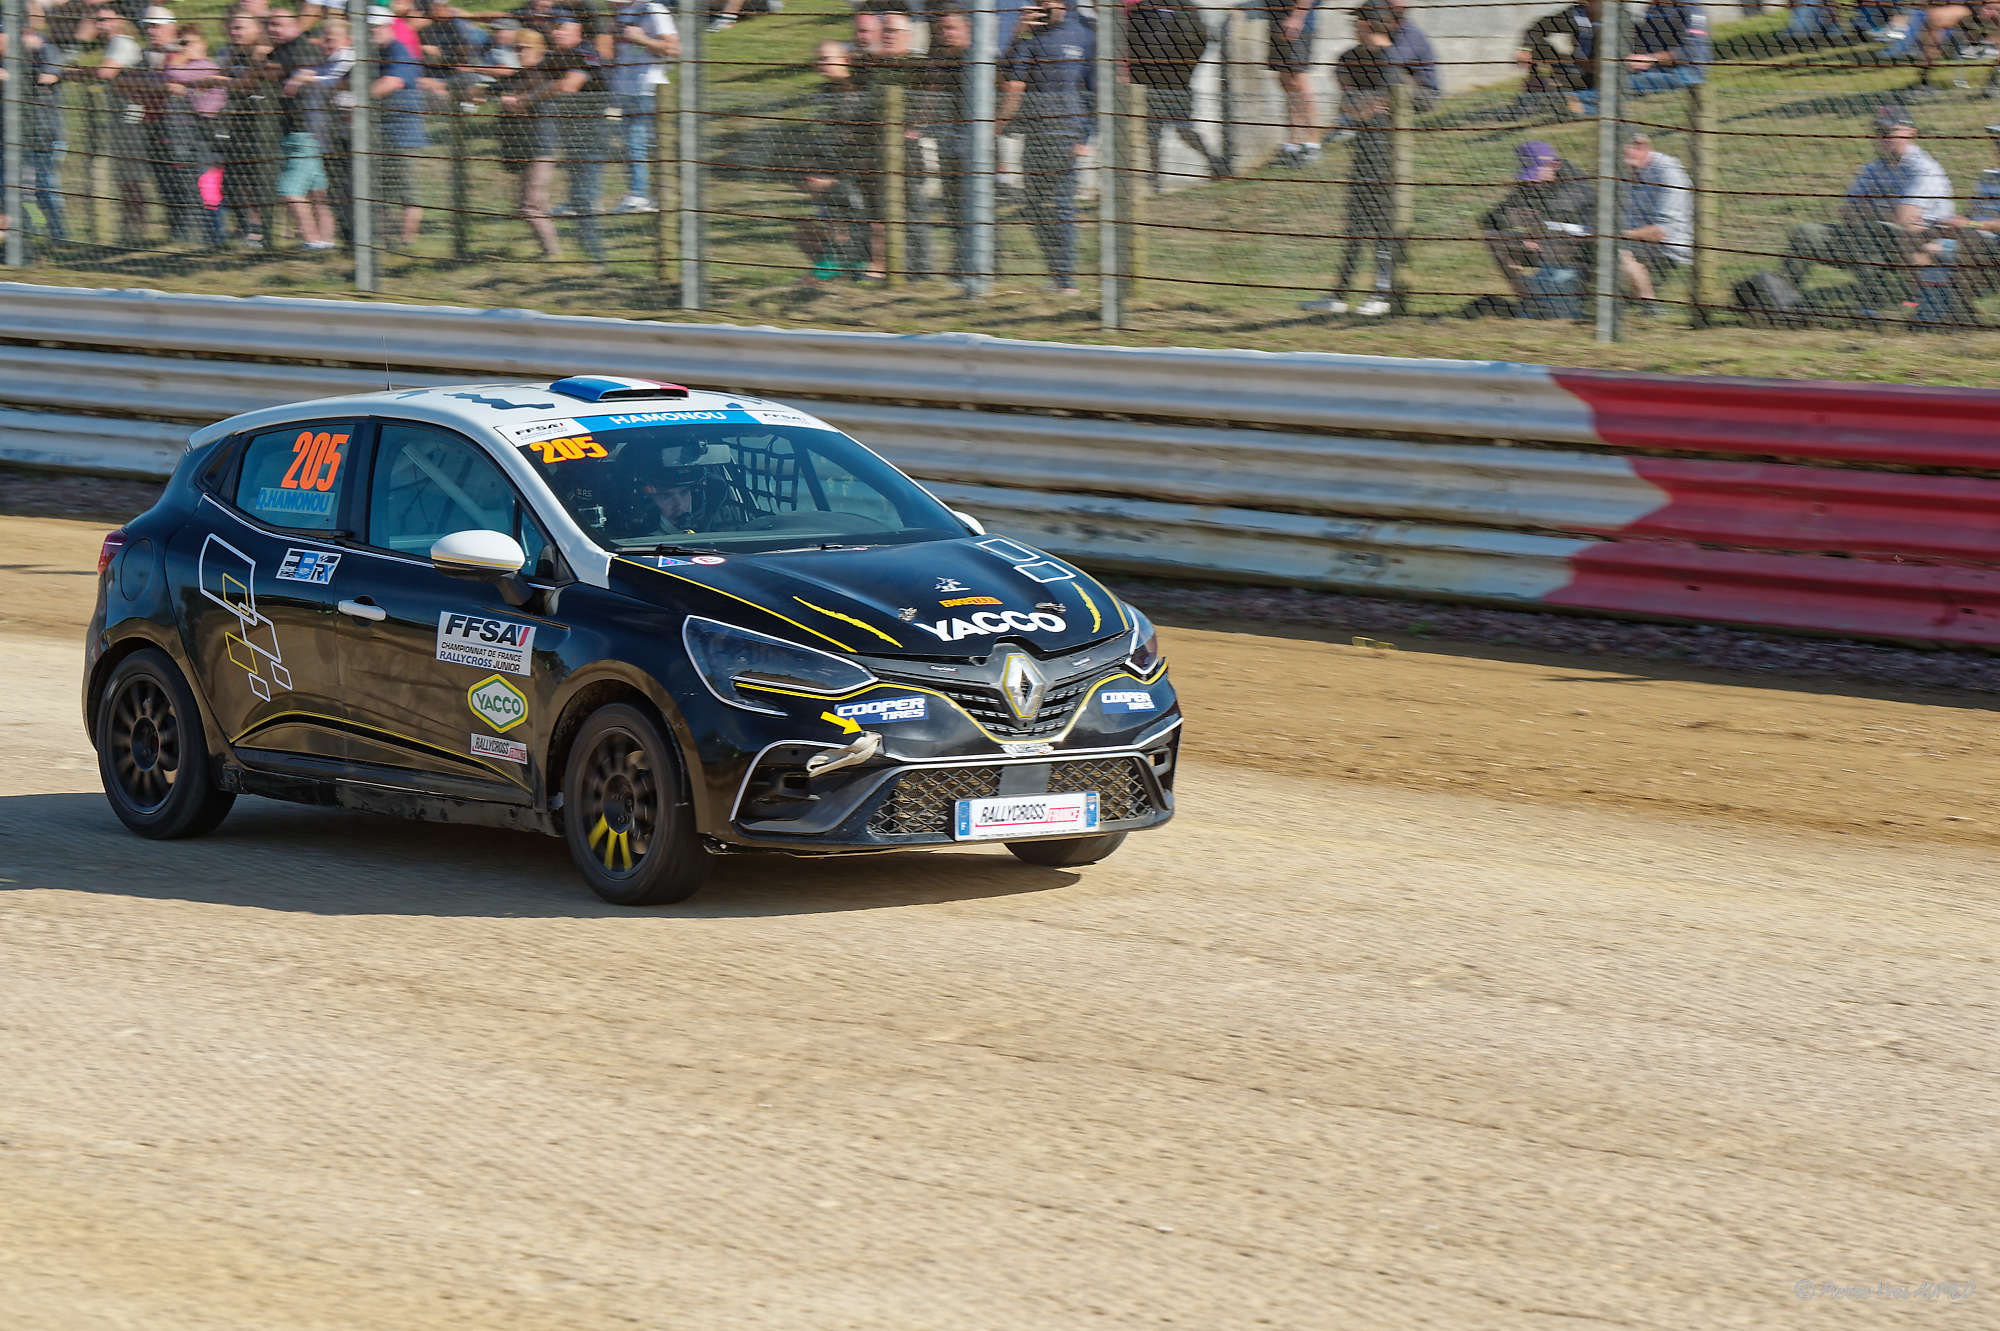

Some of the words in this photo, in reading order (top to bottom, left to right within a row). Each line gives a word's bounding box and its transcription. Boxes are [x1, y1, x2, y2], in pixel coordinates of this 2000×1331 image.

[609, 411, 728, 425] HAMONOU
[530, 436, 609, 464] 205
[280, 431, 350, 492] 205
[445, 614, 517, 646] FFSA
[914, 611, 1066, 642] YACCO
[440, 650, 493, 668] RALLYCROSS
[493, 660, 521, 673] JUNIOR
[441, 641, 487, 655] CHAMPIONNAT
[487, 650, 497, 658] DE
[497, 651, 522, 663] FRANCE
[475, 693, 521, 715] YACCO
[837, 698, 926, 716] COOPER
[1101, 691, 1152, 703] COOPER
[880, 709, 926, 720] TIRES
[475, 736, 510, 754] RALLYCROSS
[980, 803, 1047, 823] RALLYCROSS
